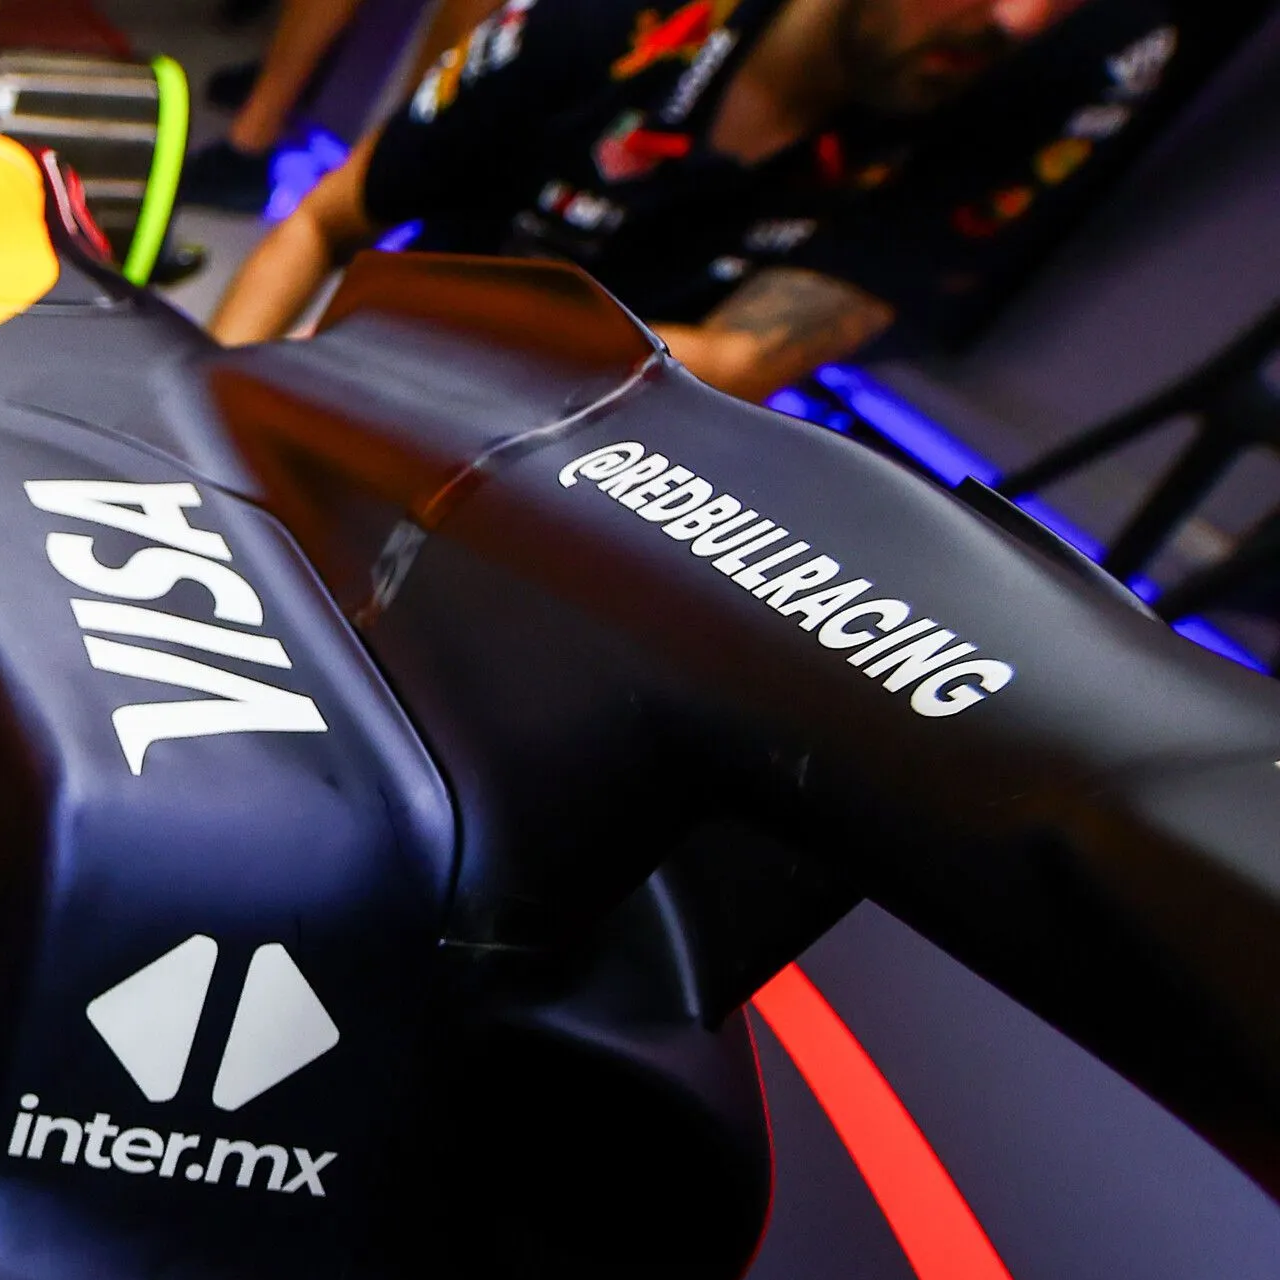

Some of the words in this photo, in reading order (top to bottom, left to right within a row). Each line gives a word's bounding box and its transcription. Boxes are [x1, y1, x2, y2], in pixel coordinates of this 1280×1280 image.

[24, 480, 328, 776] VISA
[558, 441, 1016, 718] @REDBULLRACING
[7, 1093, 338, 1197] inter.mx
